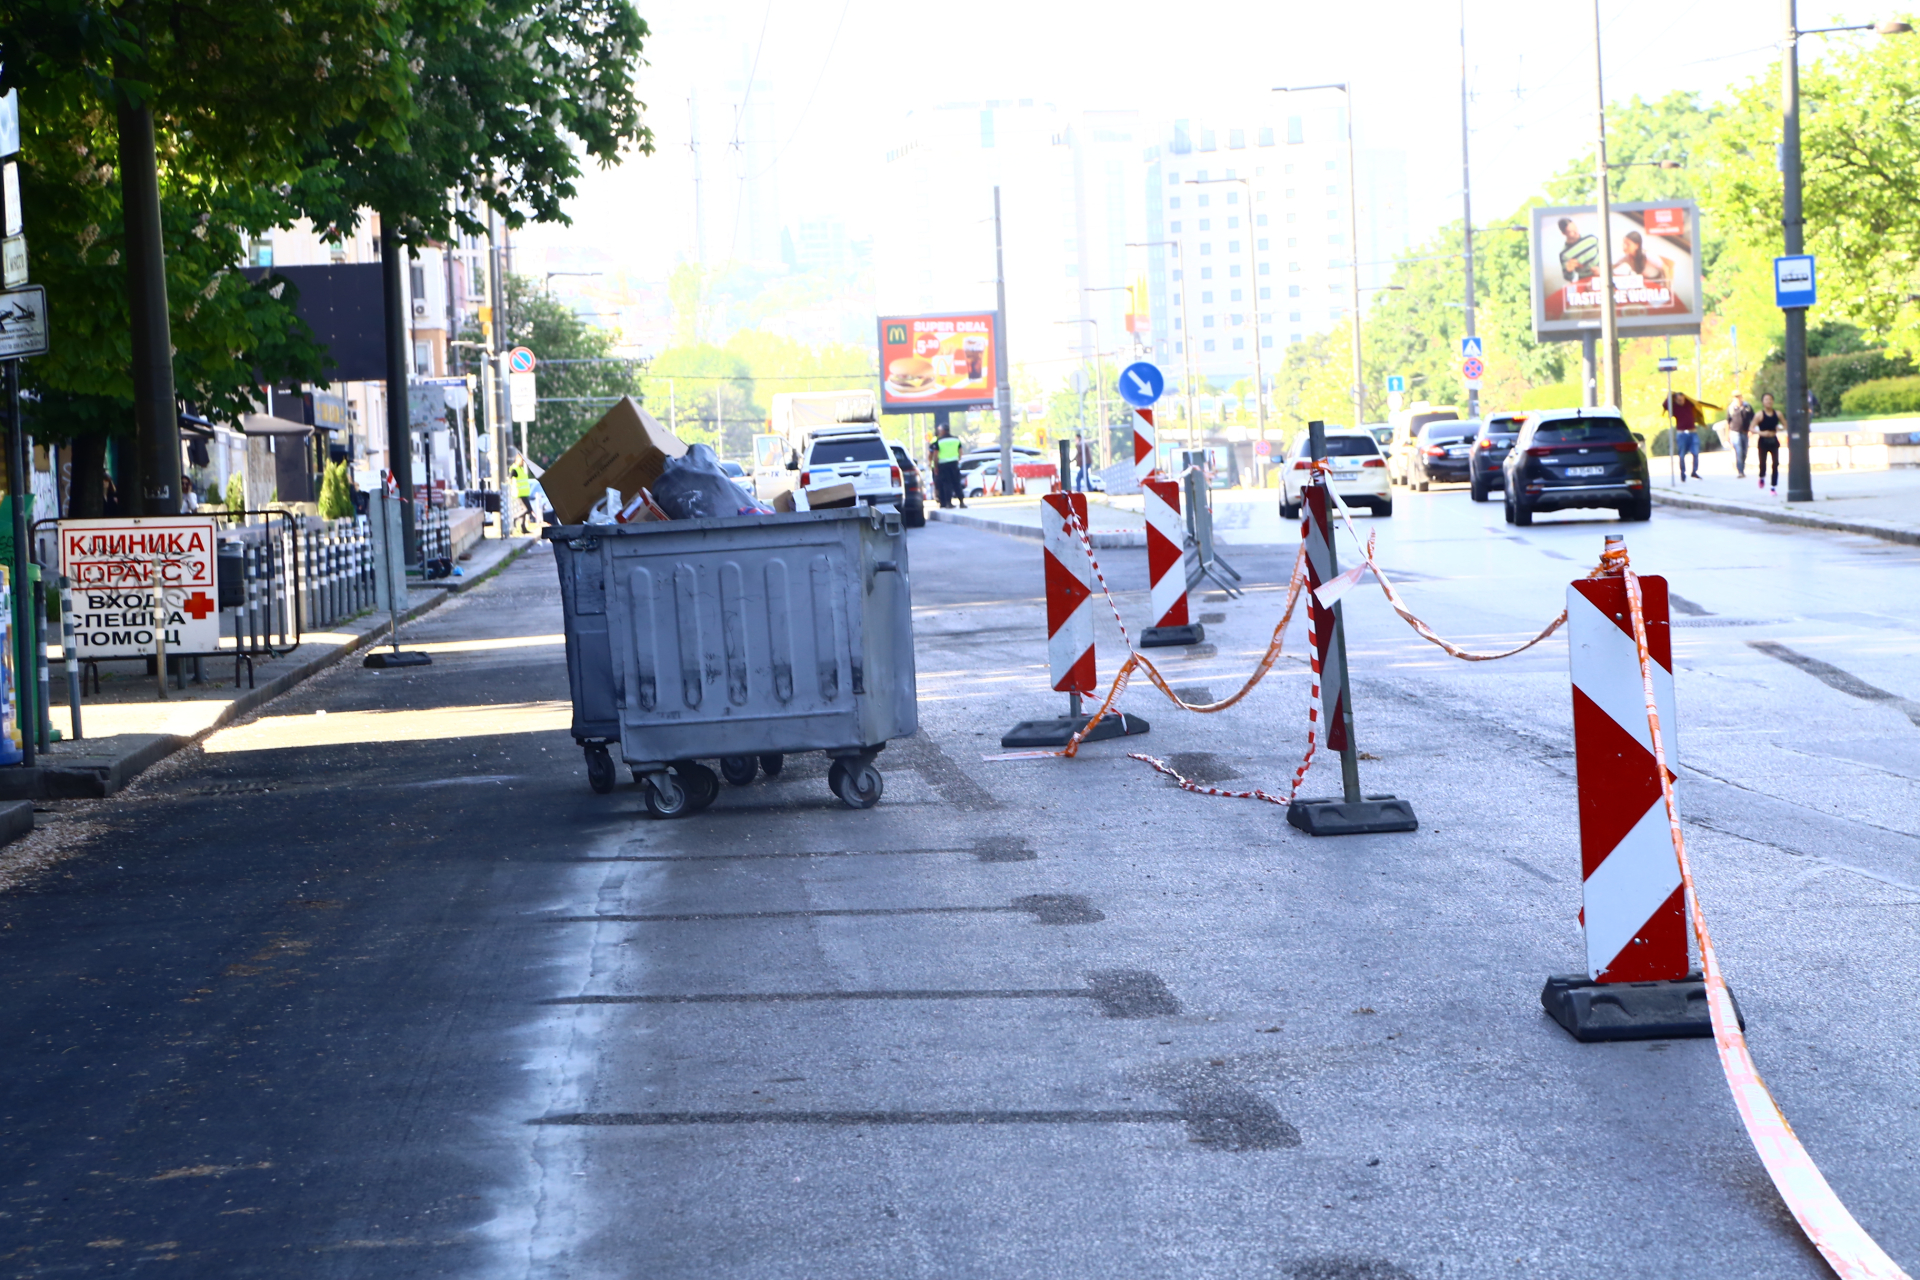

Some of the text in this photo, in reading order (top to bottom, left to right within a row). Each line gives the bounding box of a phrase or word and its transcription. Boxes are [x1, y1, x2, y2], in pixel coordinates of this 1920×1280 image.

[1627, 287, 1670, 303] WORLD
[913, 321, 989, 333] SUPER DEAL
[70, 532, 205, 556] КЛИНИКА
[192, 561, 206, 581] 2
